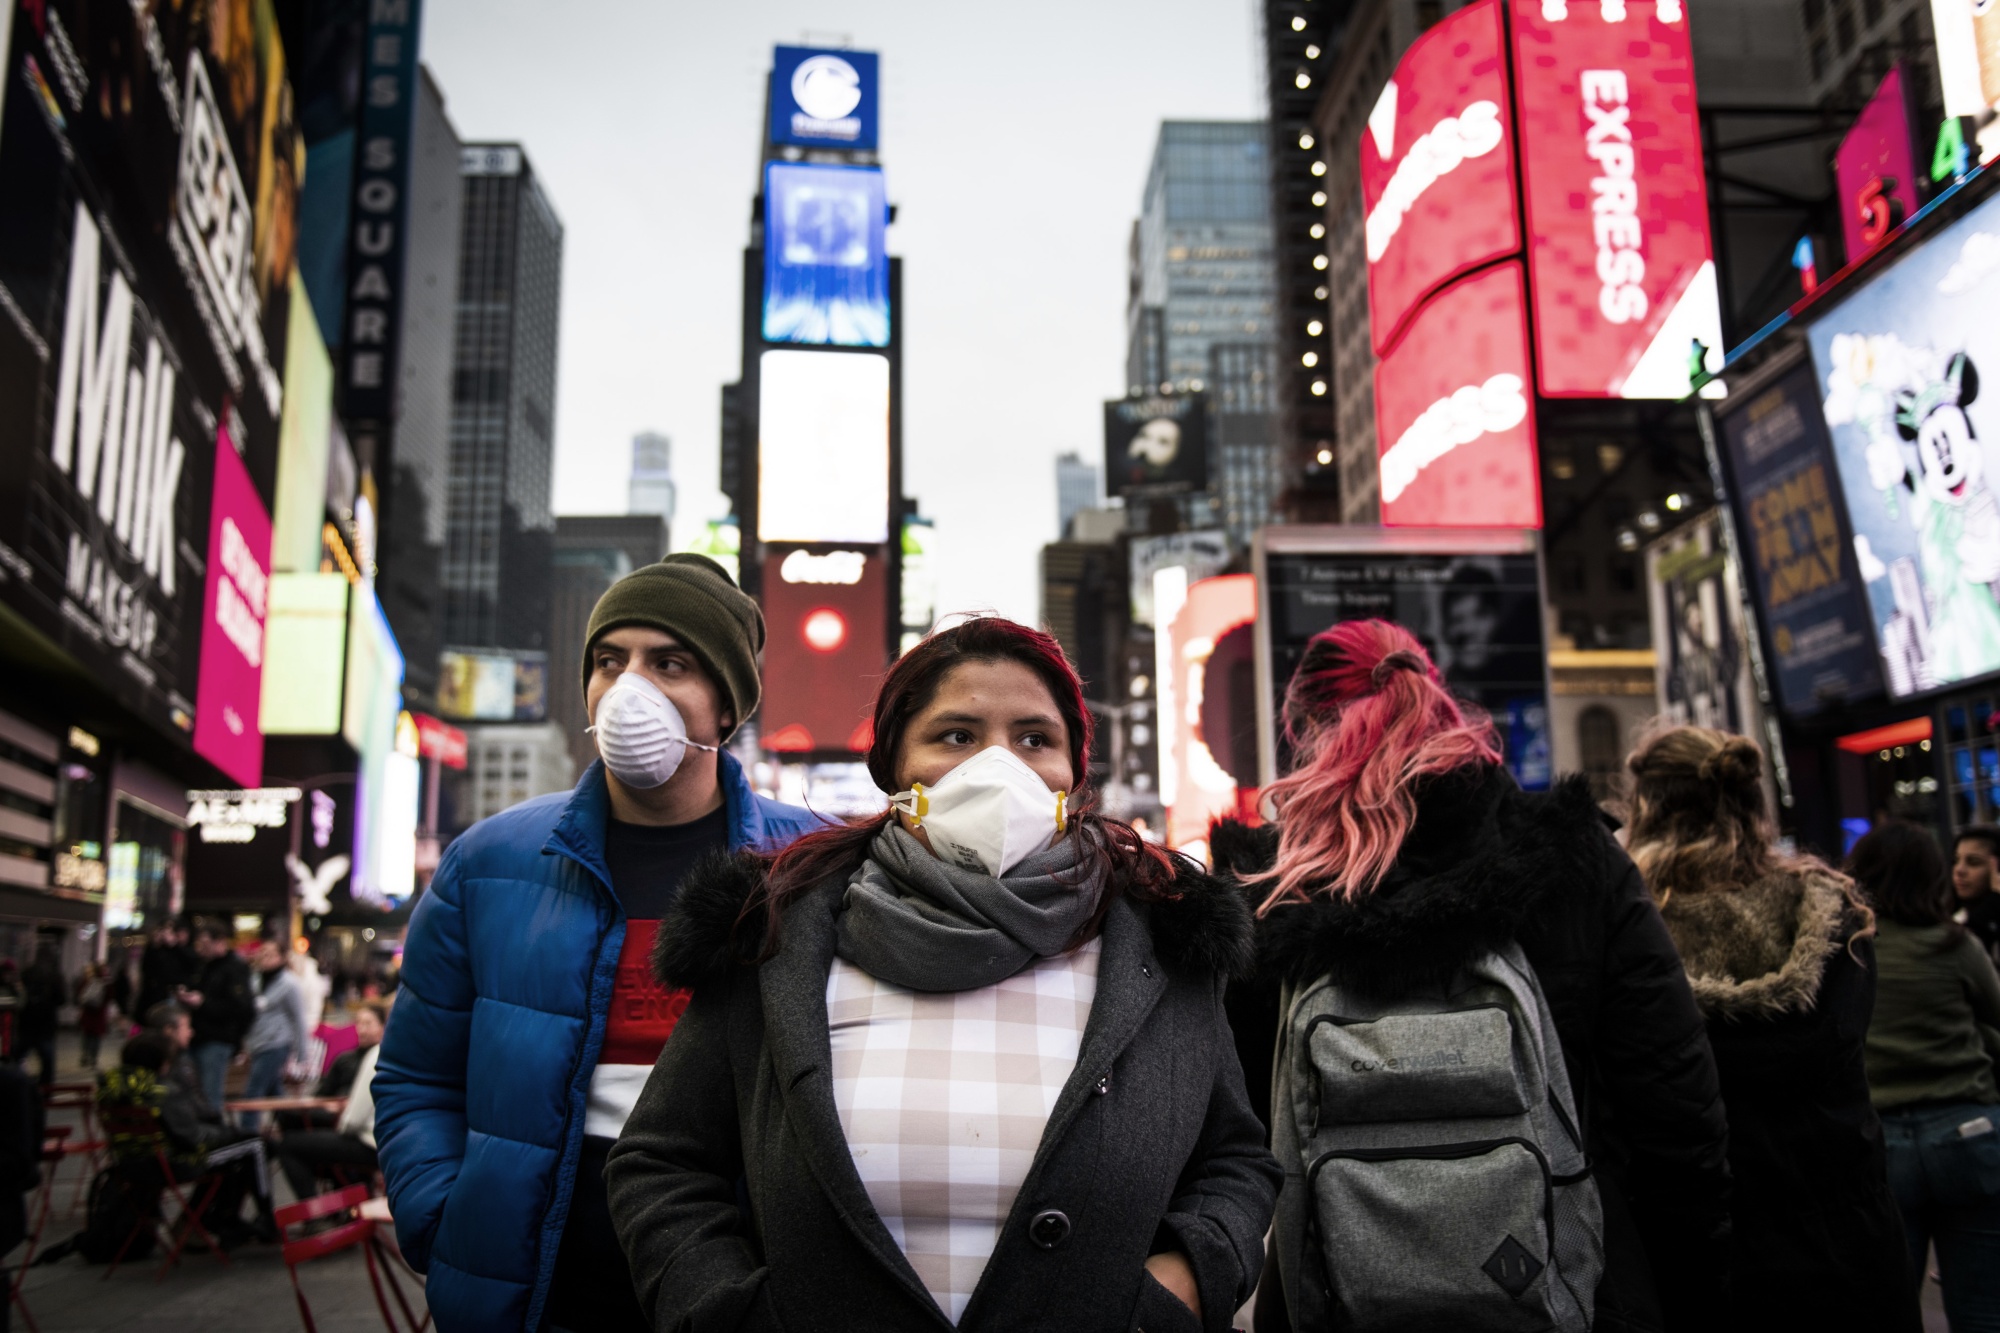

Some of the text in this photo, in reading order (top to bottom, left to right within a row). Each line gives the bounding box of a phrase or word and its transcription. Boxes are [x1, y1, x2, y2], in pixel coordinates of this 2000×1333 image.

[351, 137, 398, 388] SQUARE
[1580, 69, 1648, 324] EXPRESS
[52, 199, 185, 597] Milk
